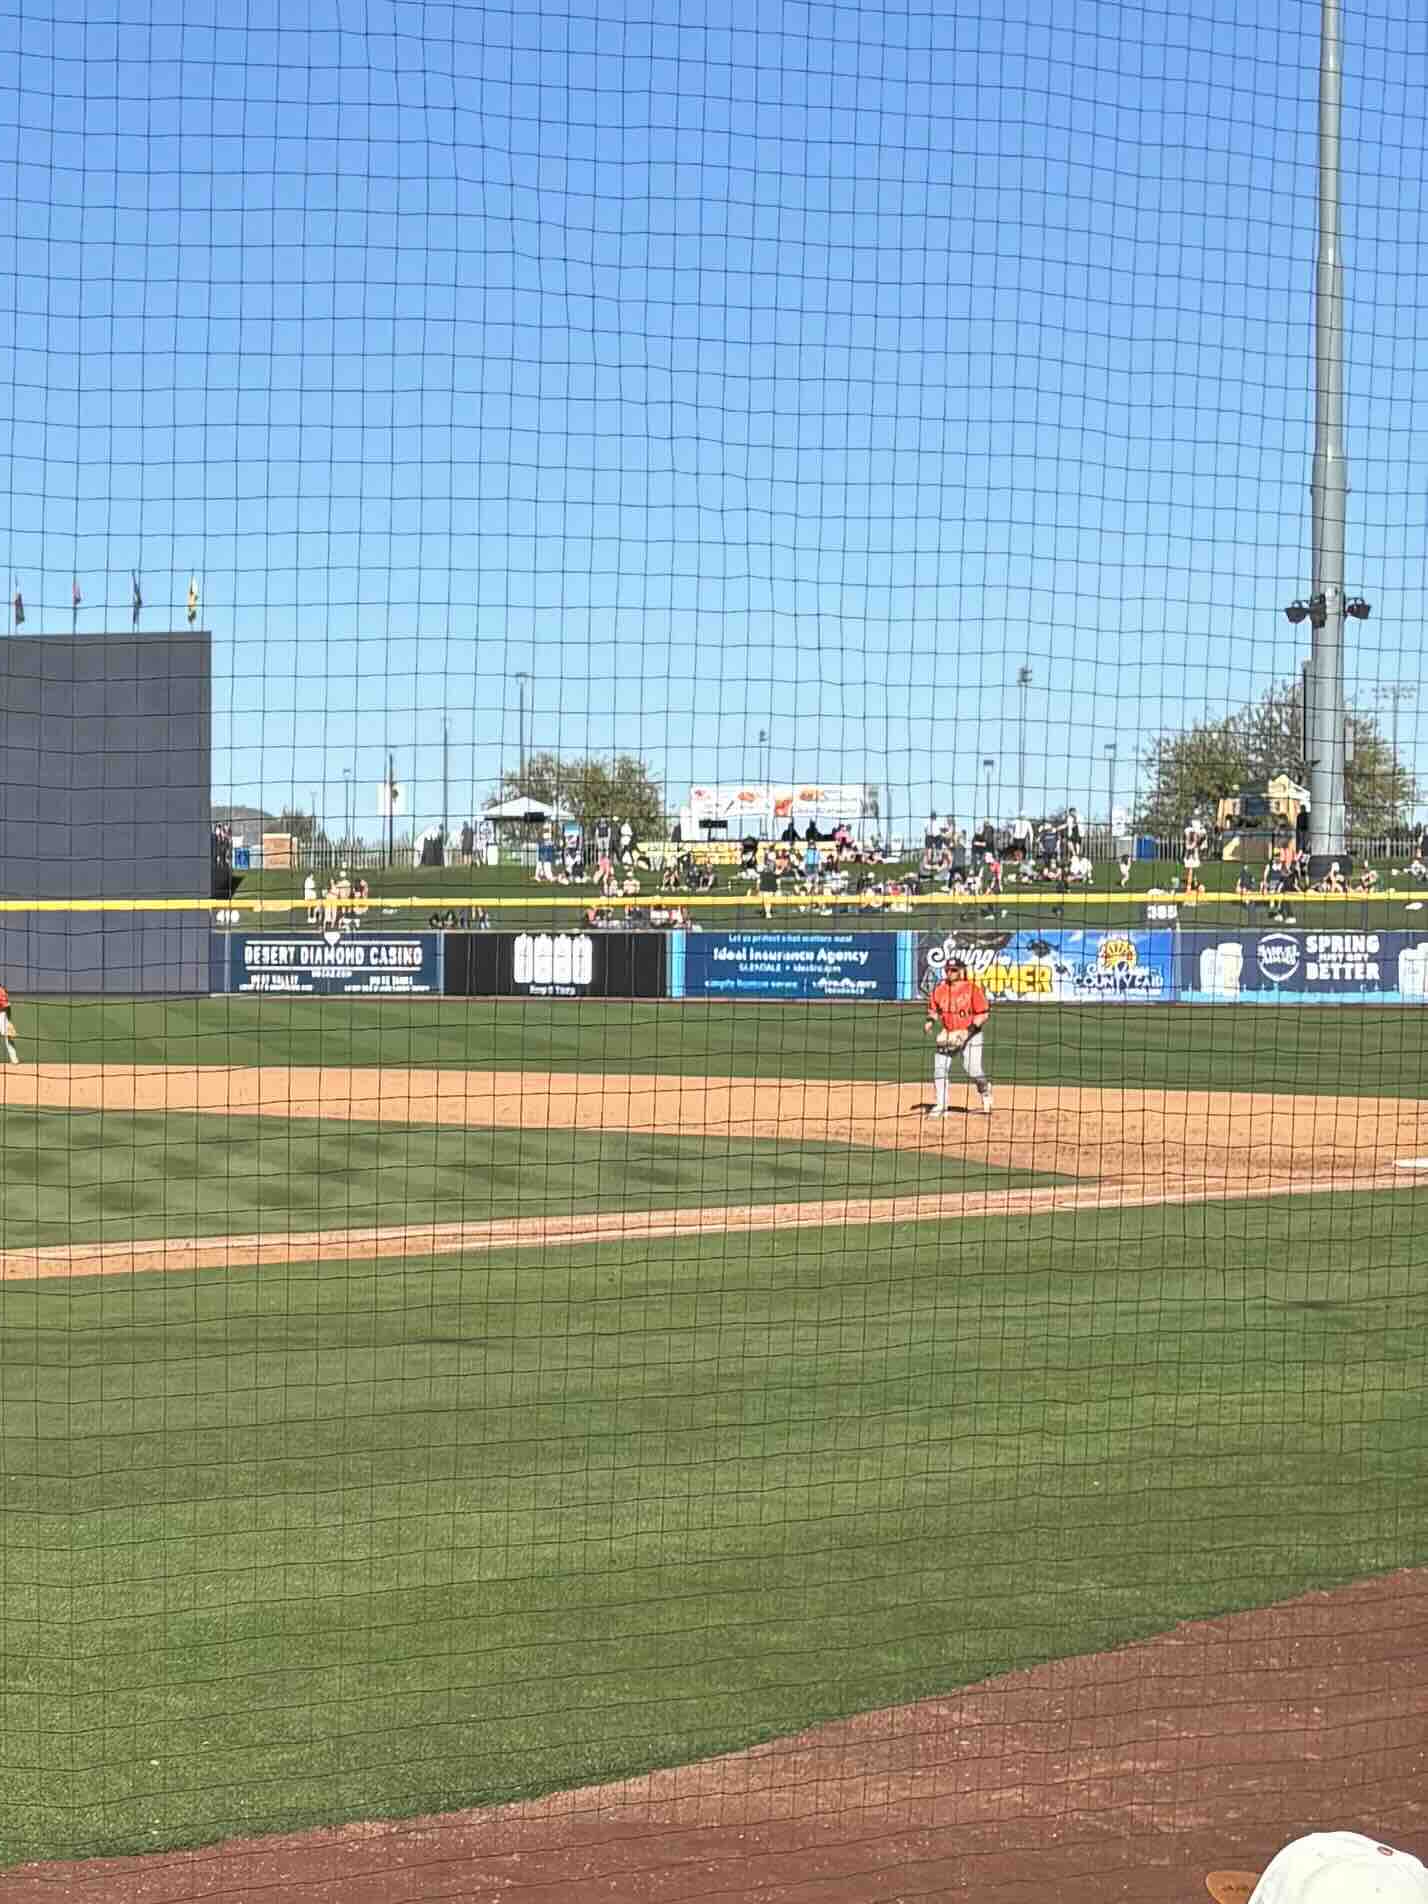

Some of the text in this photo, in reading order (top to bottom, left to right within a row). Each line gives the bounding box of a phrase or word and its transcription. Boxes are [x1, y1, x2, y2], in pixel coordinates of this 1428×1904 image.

[1306, 935, 1380, 953] SPRING
[245, 947, 423, 965] DESERT DIAMOND CASINO
[713, 948, 869, 965] Ideal Insurance Agency
[928, 940, 998, 973] Swing
[1306, 962, 1381, 980] BETTER
